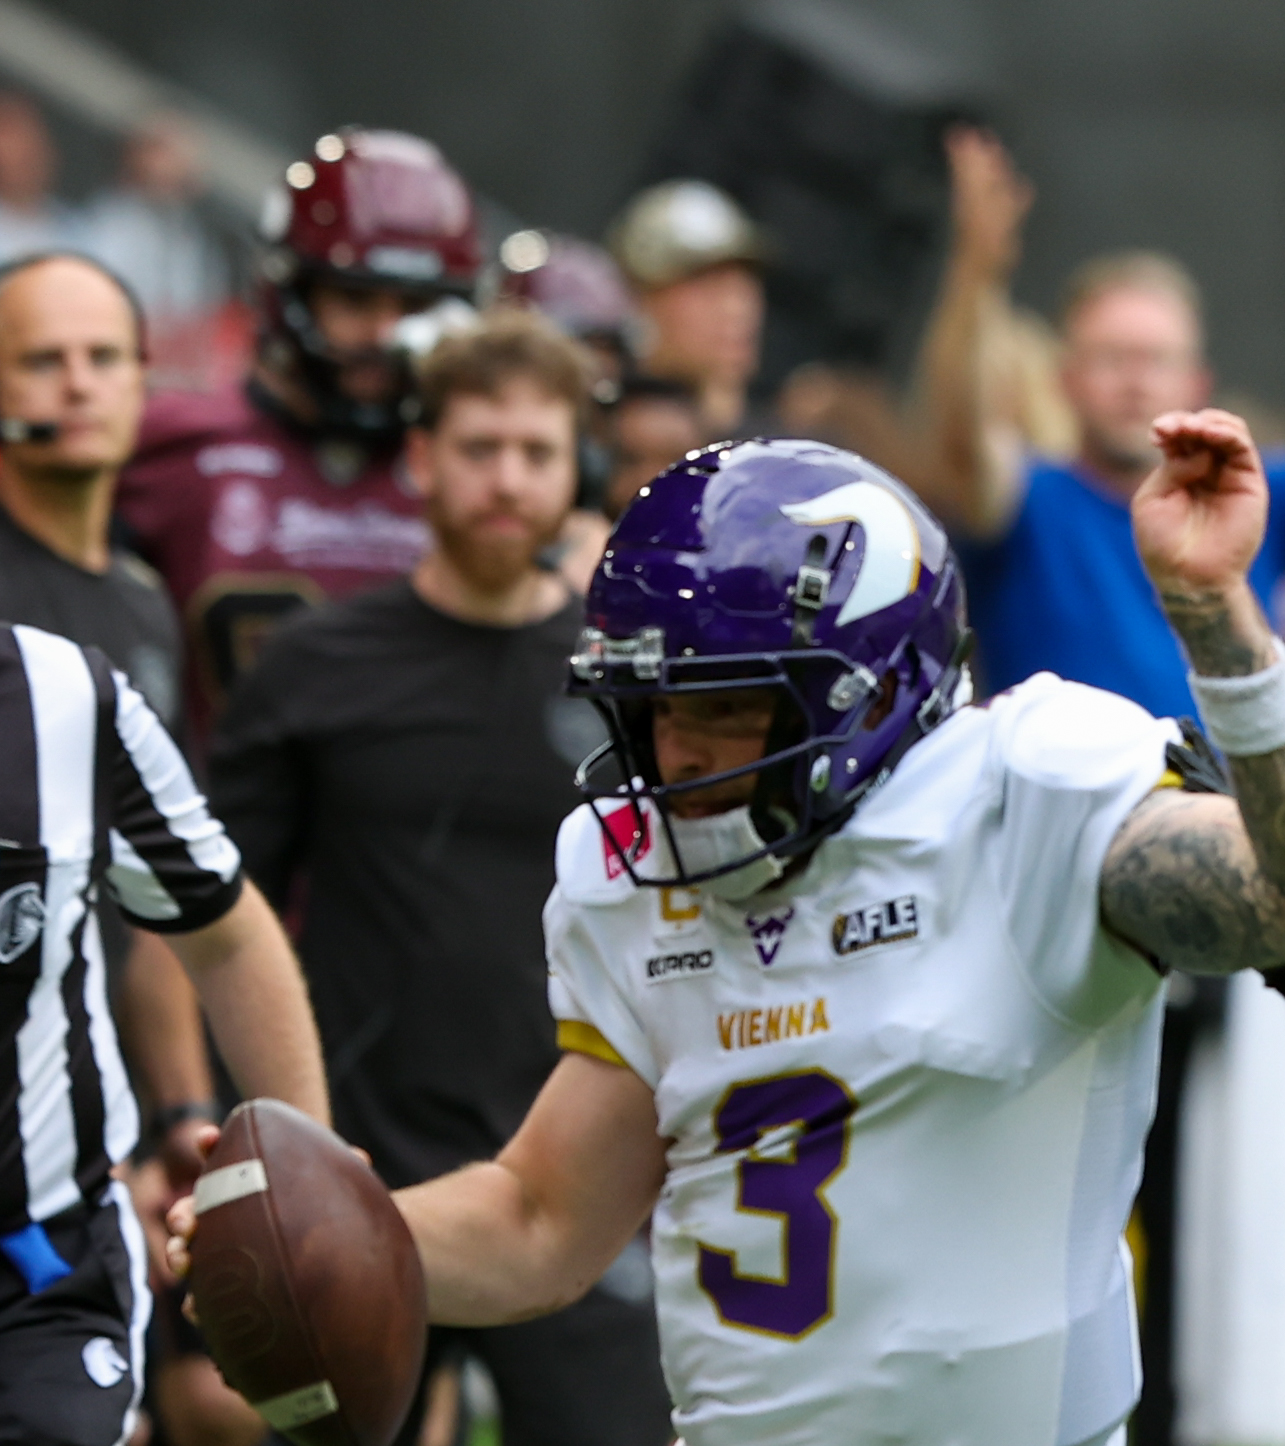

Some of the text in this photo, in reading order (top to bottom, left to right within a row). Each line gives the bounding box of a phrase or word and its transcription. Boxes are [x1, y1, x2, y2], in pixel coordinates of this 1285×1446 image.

[840, 896, 918, 951] AFLE
[716, 997, 831, 1052] VIENNA
[697, 1065, 859, 1343] 3
